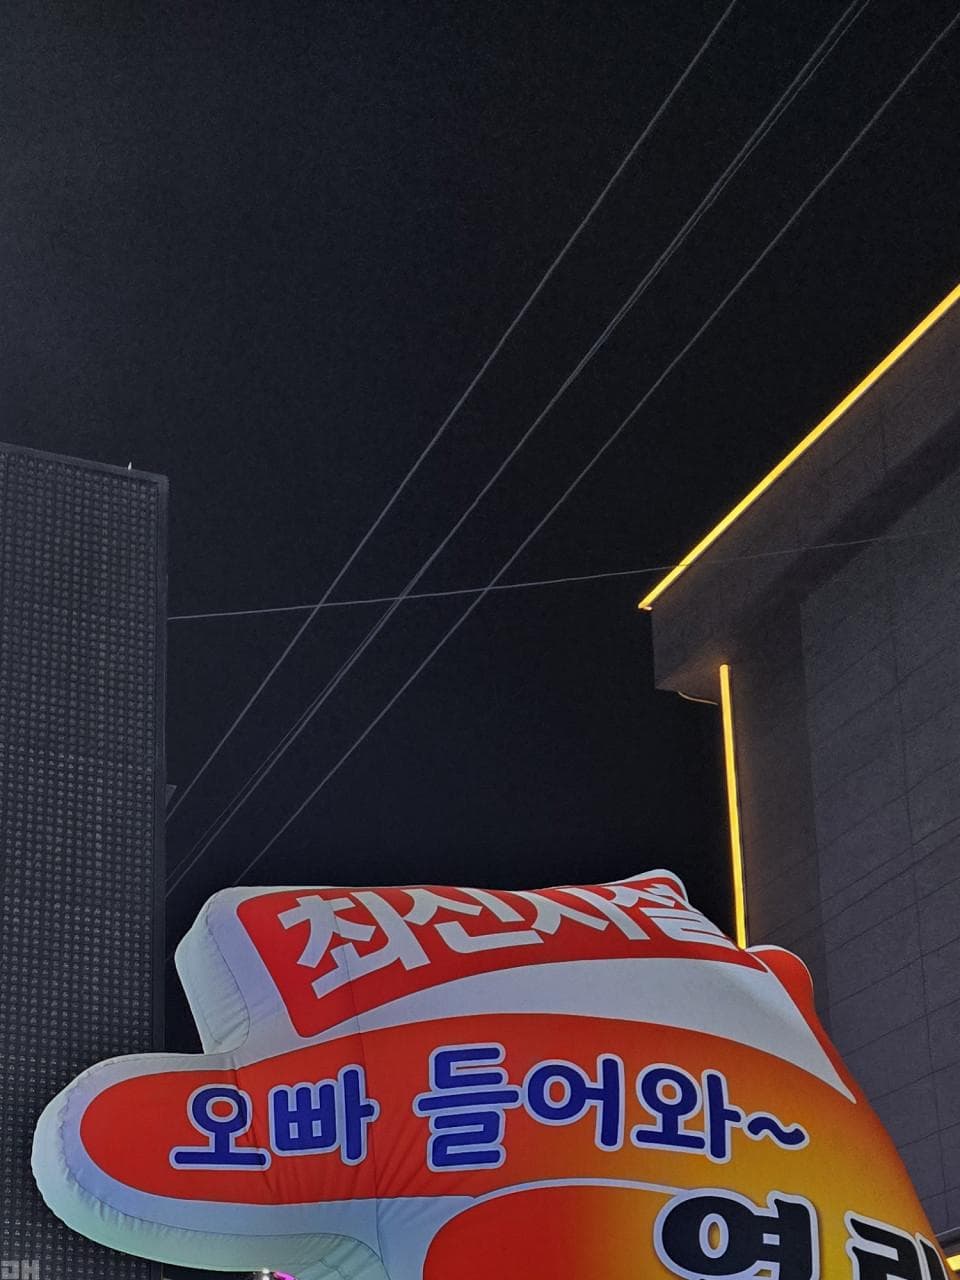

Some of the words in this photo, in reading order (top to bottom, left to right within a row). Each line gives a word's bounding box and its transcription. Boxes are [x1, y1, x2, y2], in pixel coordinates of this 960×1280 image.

[277, 884, 739, 999] 최신시설
[172, 1066, 376, 1169] 오빠
[415, 1044, 807, 1169] 들어와~
